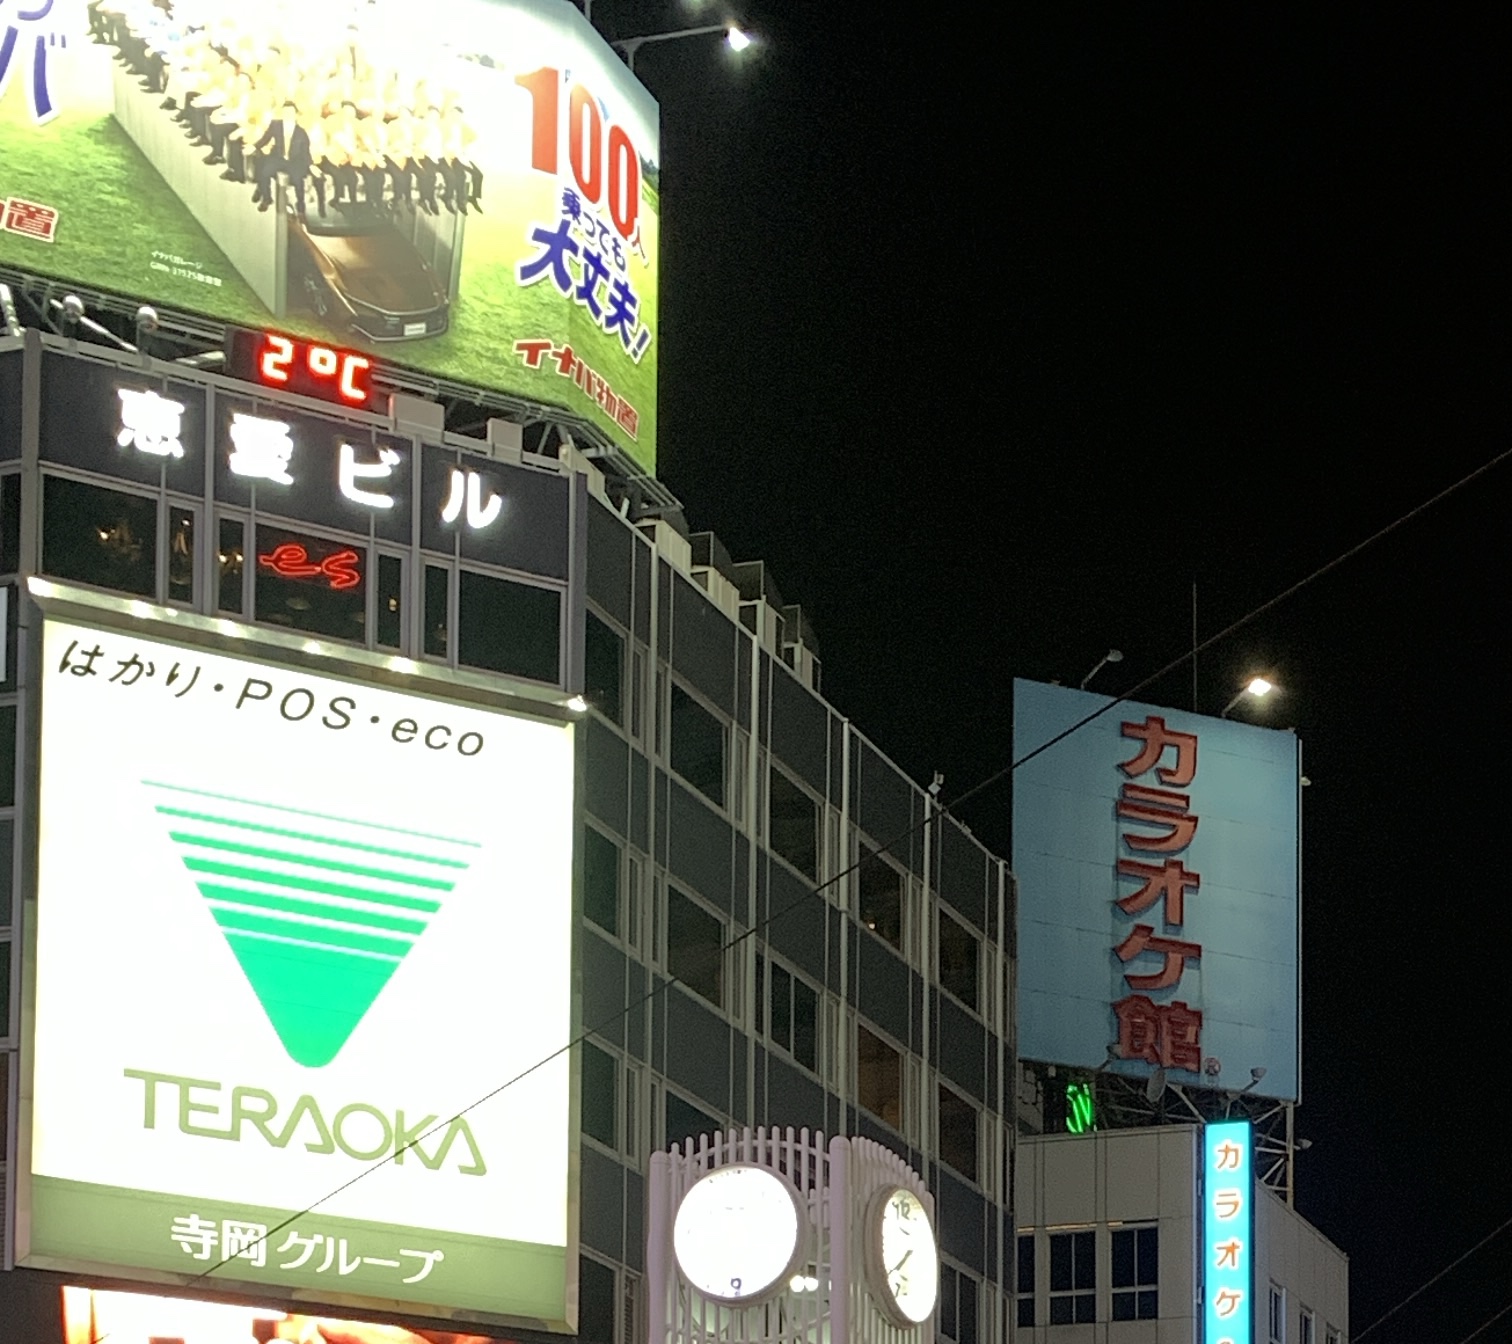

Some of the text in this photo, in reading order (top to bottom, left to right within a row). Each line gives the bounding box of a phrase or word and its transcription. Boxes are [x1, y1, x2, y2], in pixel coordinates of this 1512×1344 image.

[0, 200, 55, 238] 置
[562, 188, 625, 270] 乗っても
[515, 342, 638, 439] イナバ物置
[1115, 716, 1202, 1073] カラオケ館
[124, 1069, 487, 1176] TERAOKA
